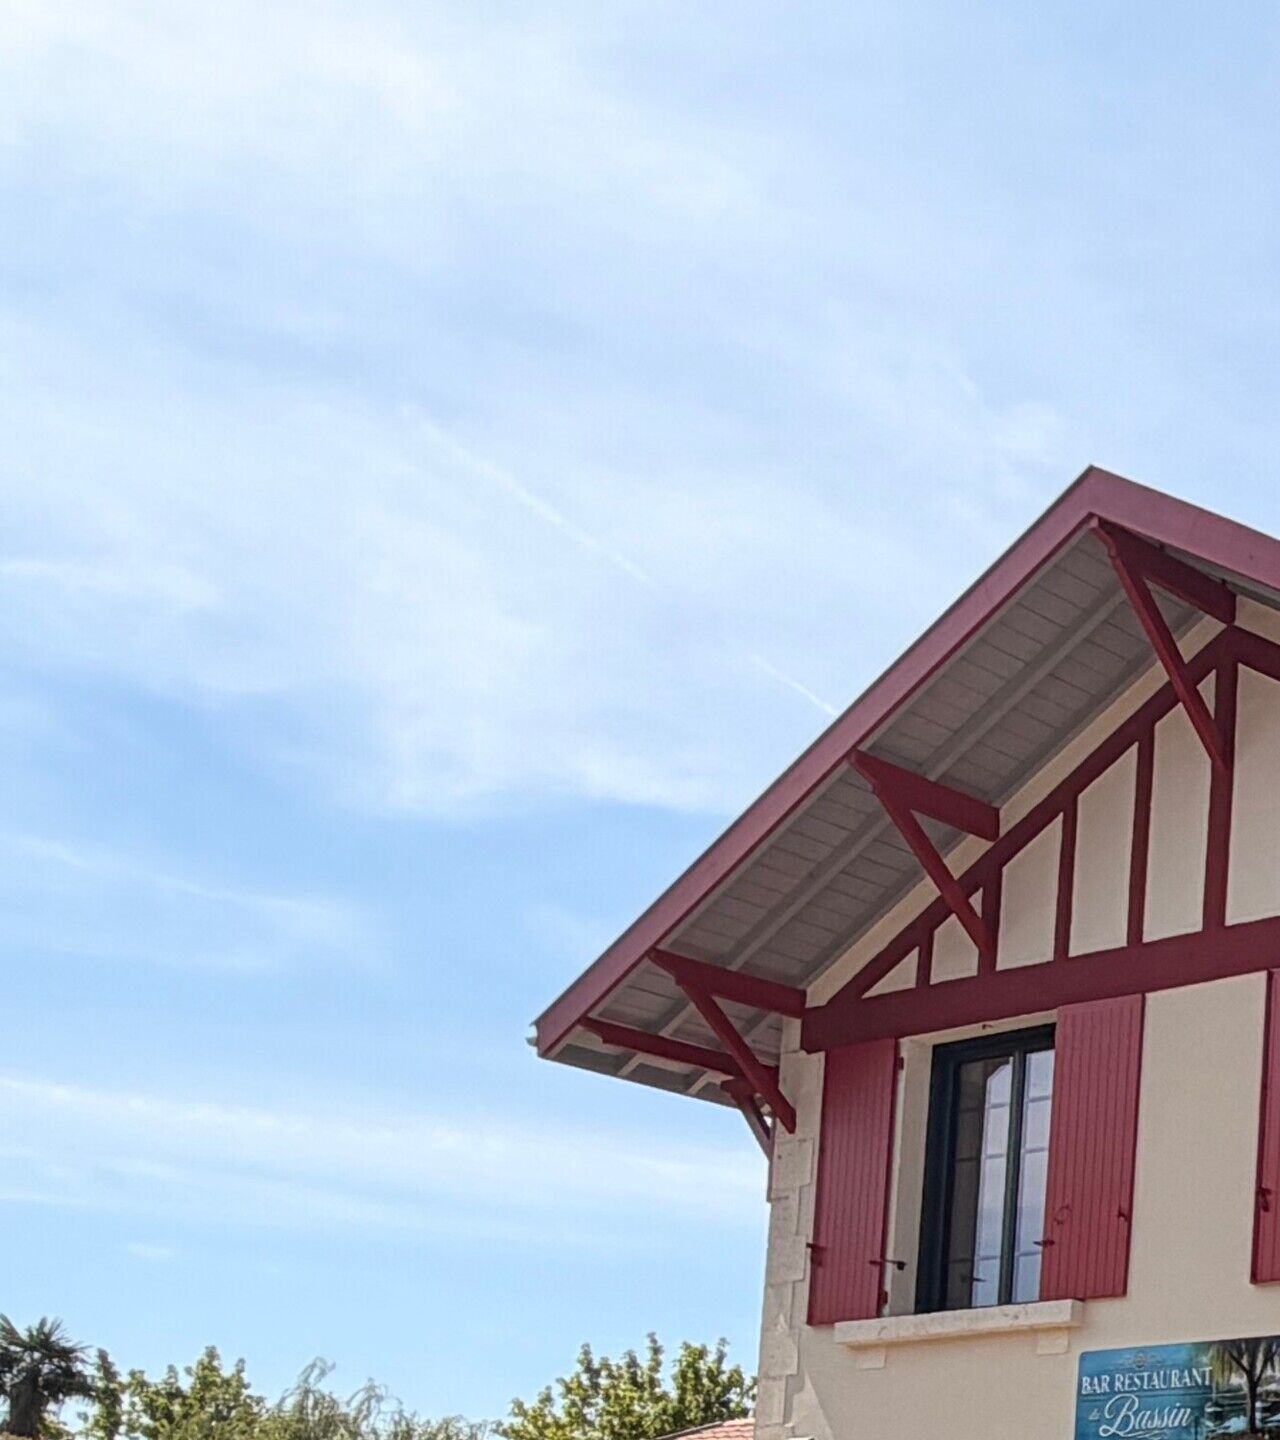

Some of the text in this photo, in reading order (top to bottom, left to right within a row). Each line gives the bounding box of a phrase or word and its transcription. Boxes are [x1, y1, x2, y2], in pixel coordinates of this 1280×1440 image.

[1081, 1366, 1213, 1395] BAR RESTAURANT
[1099, 1393, 1192, 1438] Bassin
